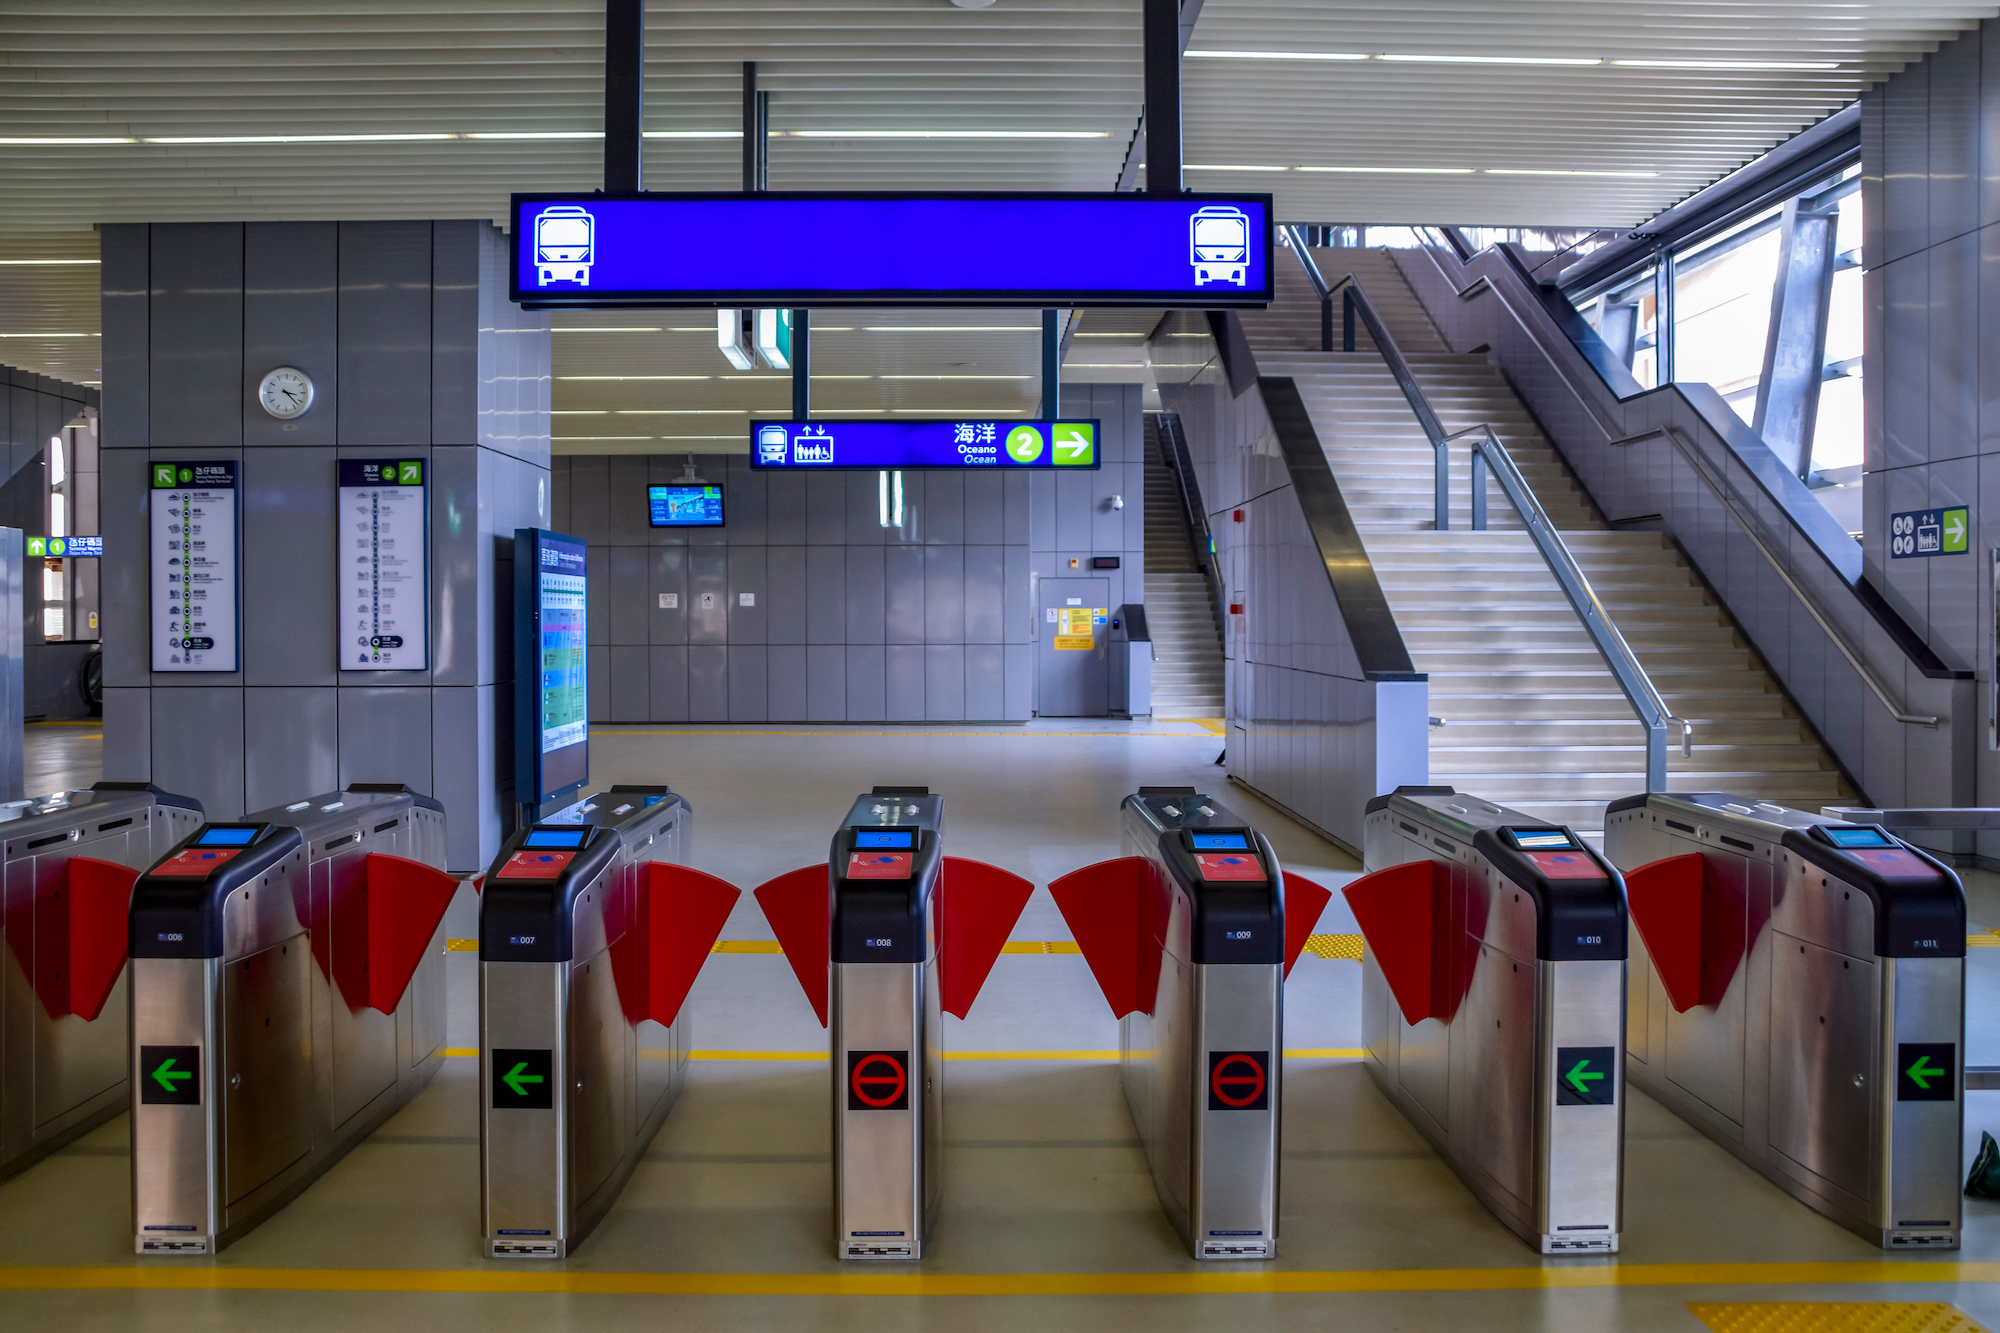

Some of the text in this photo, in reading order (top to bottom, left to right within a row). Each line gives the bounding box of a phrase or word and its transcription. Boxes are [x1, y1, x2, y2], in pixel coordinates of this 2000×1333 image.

[954, 423, 996, 444] 海洋
[1017, 433, 1032, 455] 2
[958, 444, 997, 454] Oceano
[964, 454, 996, 463] Ocean
[386, 469, 392, 478] 2
[54, 542, 59, 551] 1
